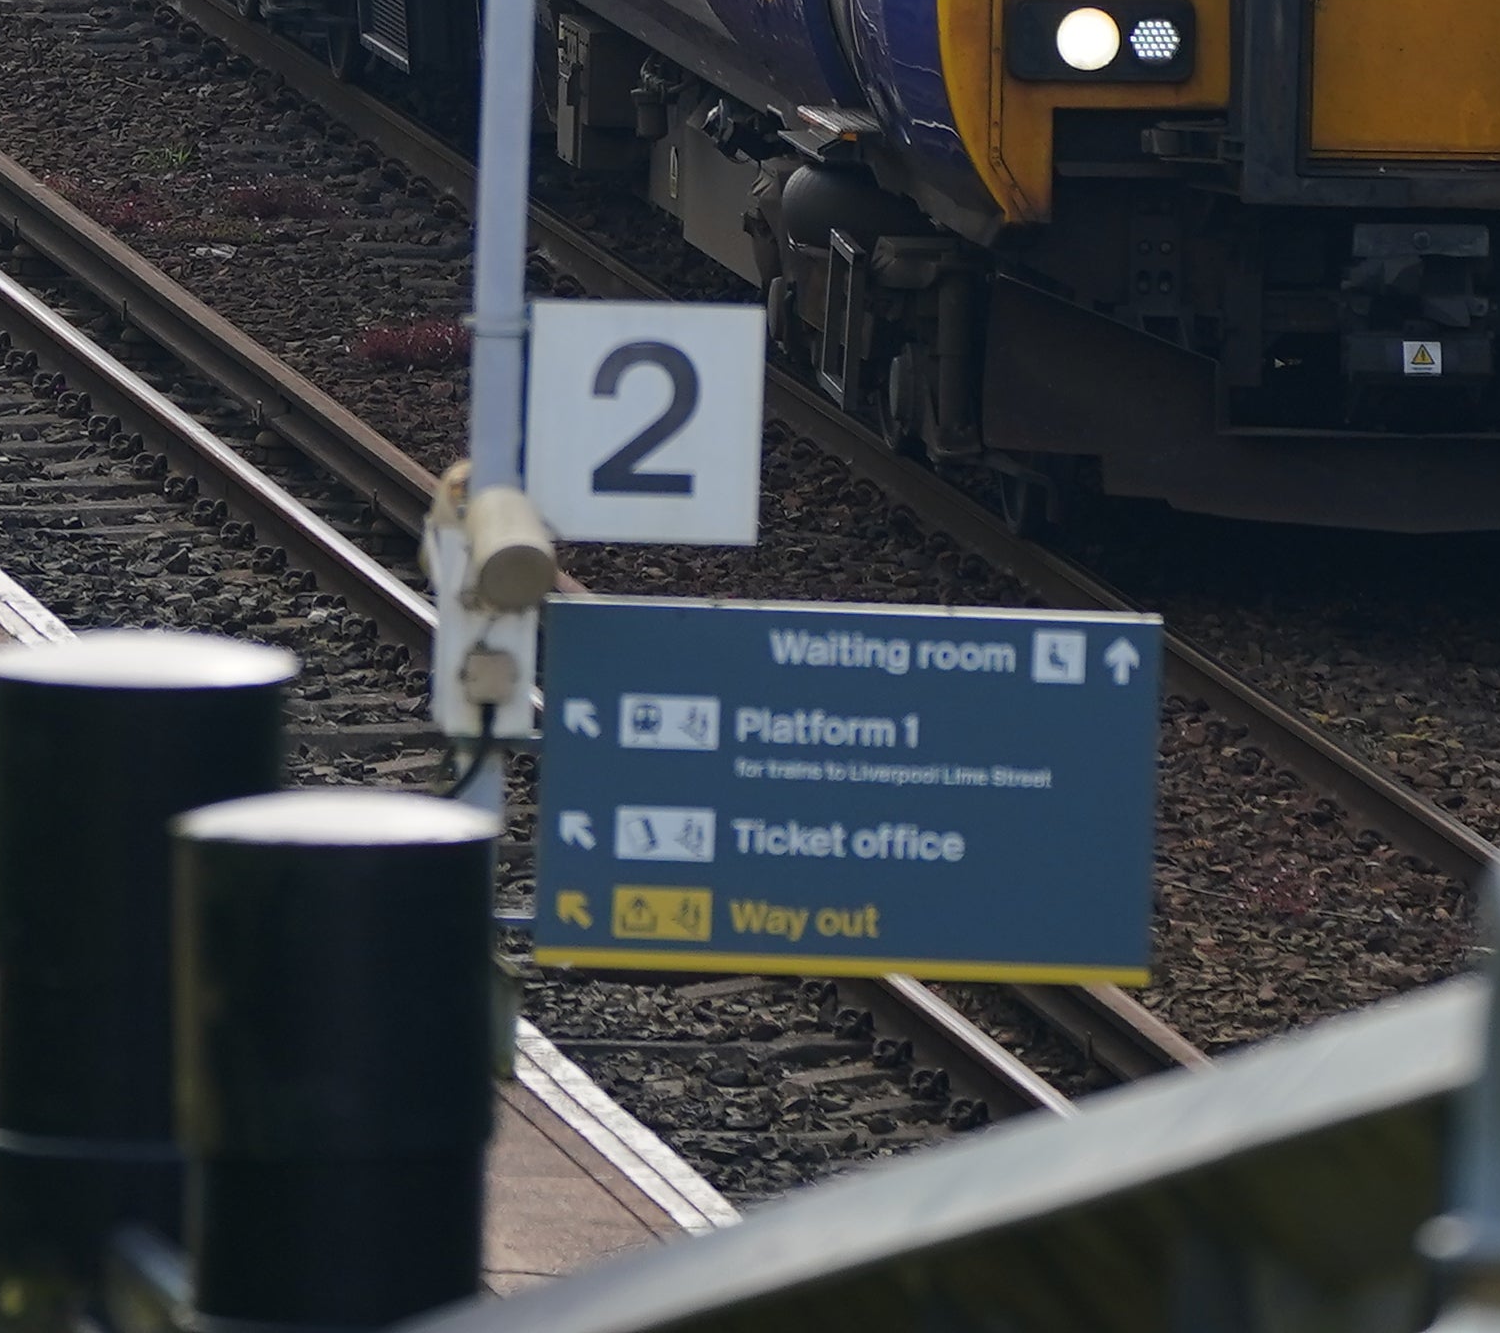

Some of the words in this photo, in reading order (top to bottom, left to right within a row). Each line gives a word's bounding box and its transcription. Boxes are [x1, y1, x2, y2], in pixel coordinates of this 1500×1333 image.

[590, 340, 703, 497] 2
[769, 627, 909, 674] Waiting
[918, 638, 1017, 674] room
[735, 707, 896, 749] Platform
[903, 713, 920, 749] 1
[733, 757, 763, 778] for
[765, 757, 824, 781] trains
[824, 760, 848, 781] to
[849, 761, 941, 787] Liverpool
[943, 764, 989, 786] Lime
[991, 764, 1053, 789] Street
[730, 821, 846, 859] Ticket
[850, 829, 966, 862] office
[728, 899, 809, 940] Way
[815, 904, 880, 937] out
